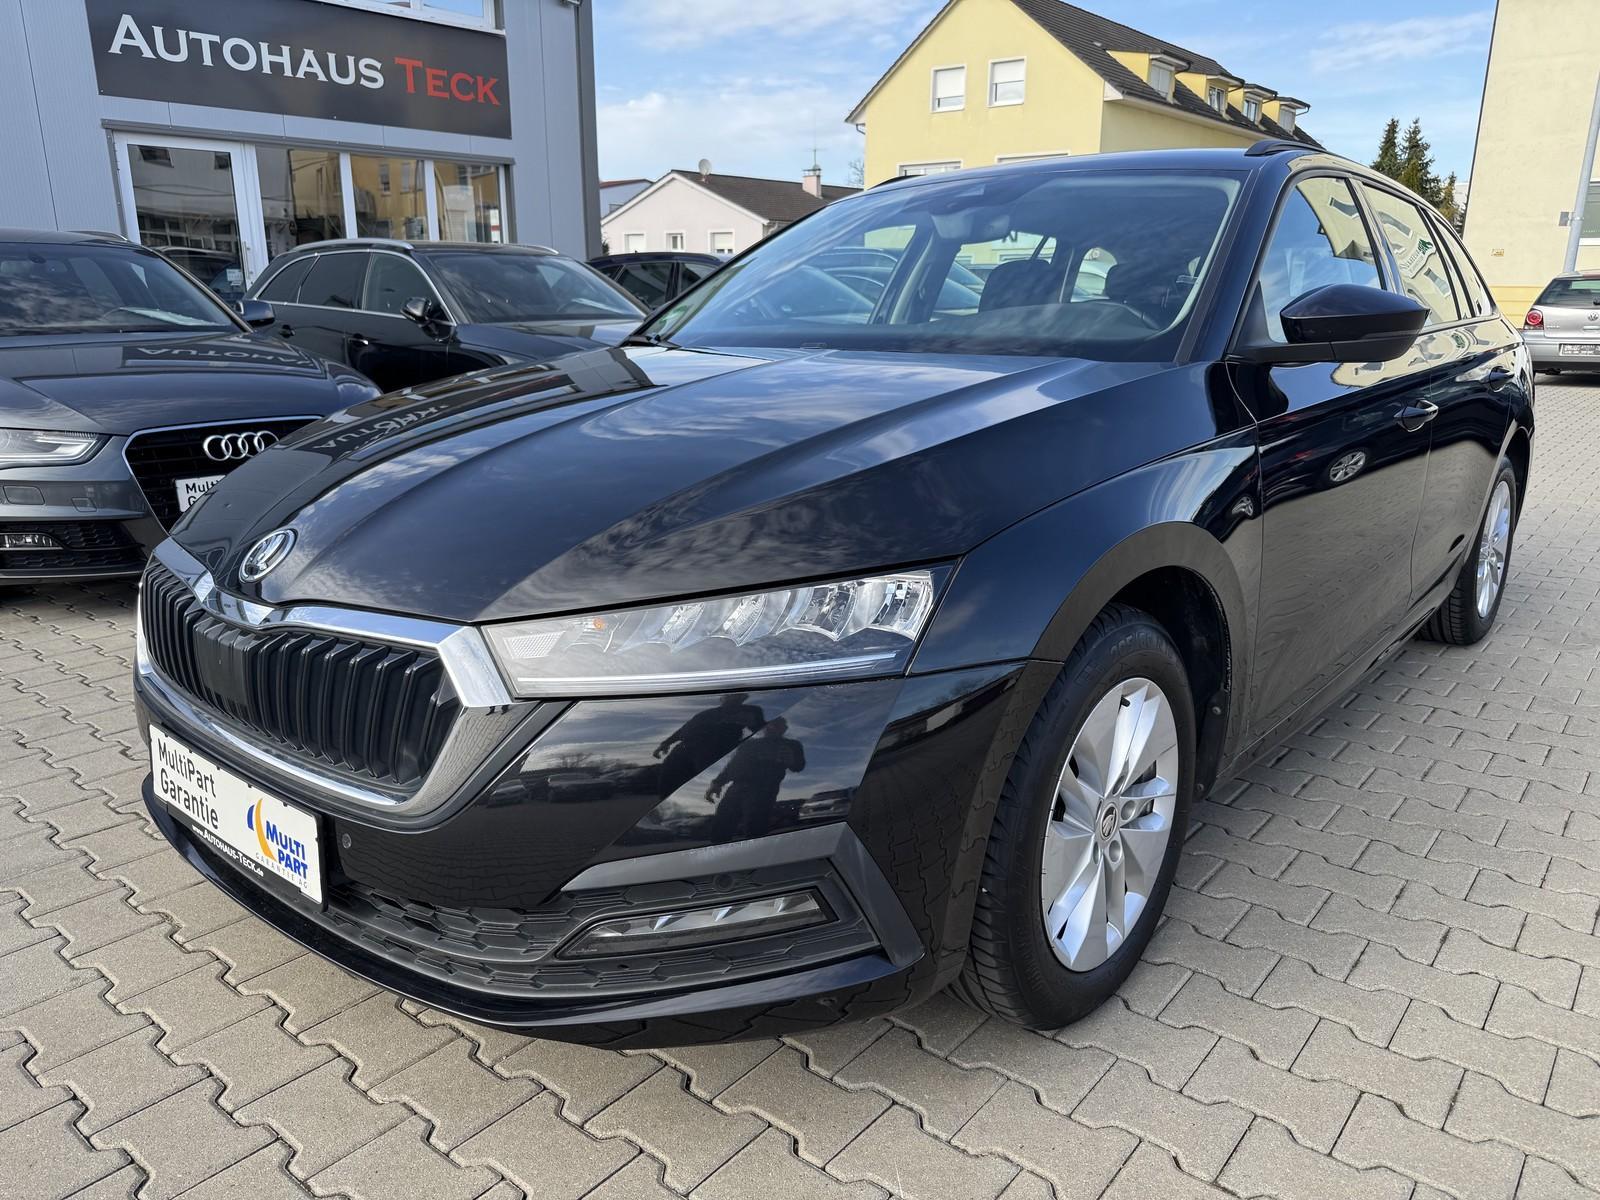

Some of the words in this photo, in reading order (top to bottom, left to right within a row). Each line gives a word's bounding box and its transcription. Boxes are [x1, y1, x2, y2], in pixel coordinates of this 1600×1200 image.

[107, 13, 385, 90] AUTOHAUS
[394, 56, 501, 106] TECK
[158, 738, 217, 798] MultiPart
[160, 768, 219, 830] Garantie
[265, 820, 306, 861] MULTI
[277, 848, 309, 880] PART
